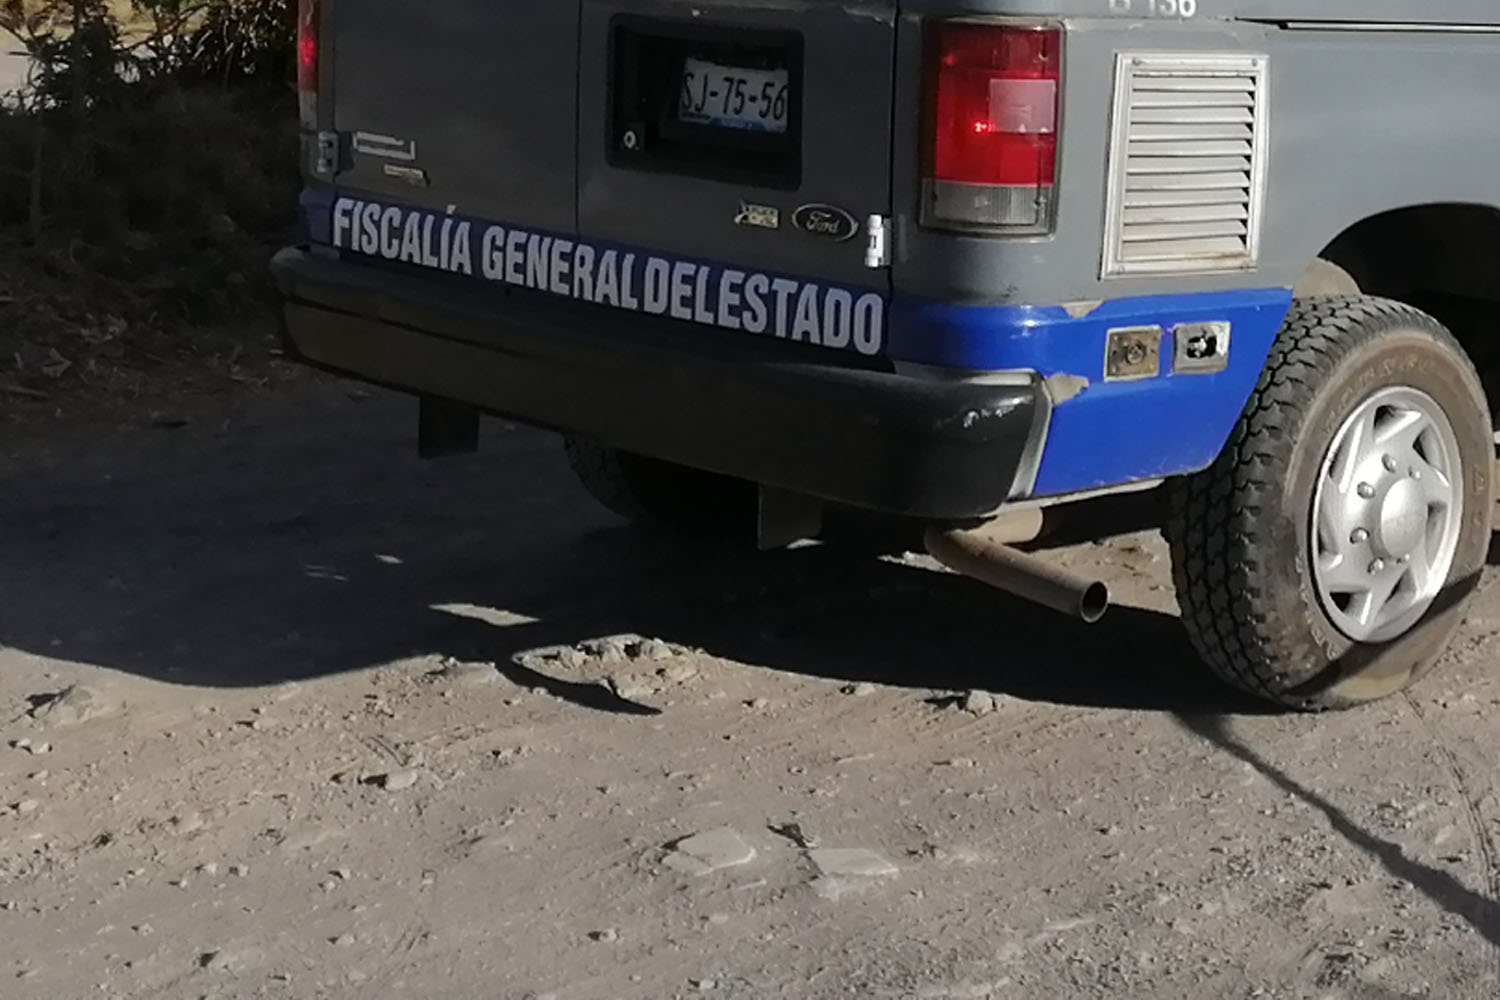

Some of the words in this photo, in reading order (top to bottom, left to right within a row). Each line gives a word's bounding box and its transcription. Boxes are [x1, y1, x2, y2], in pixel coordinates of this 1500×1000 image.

[805, 210, 841, 234] Ford
[333, 197, 473, 276] FISCALÍA
[482, 225, 639, 311] GENERAL
[643, 256, 715, 326] DEL
[717, 269, 884, 356] ESTADO
